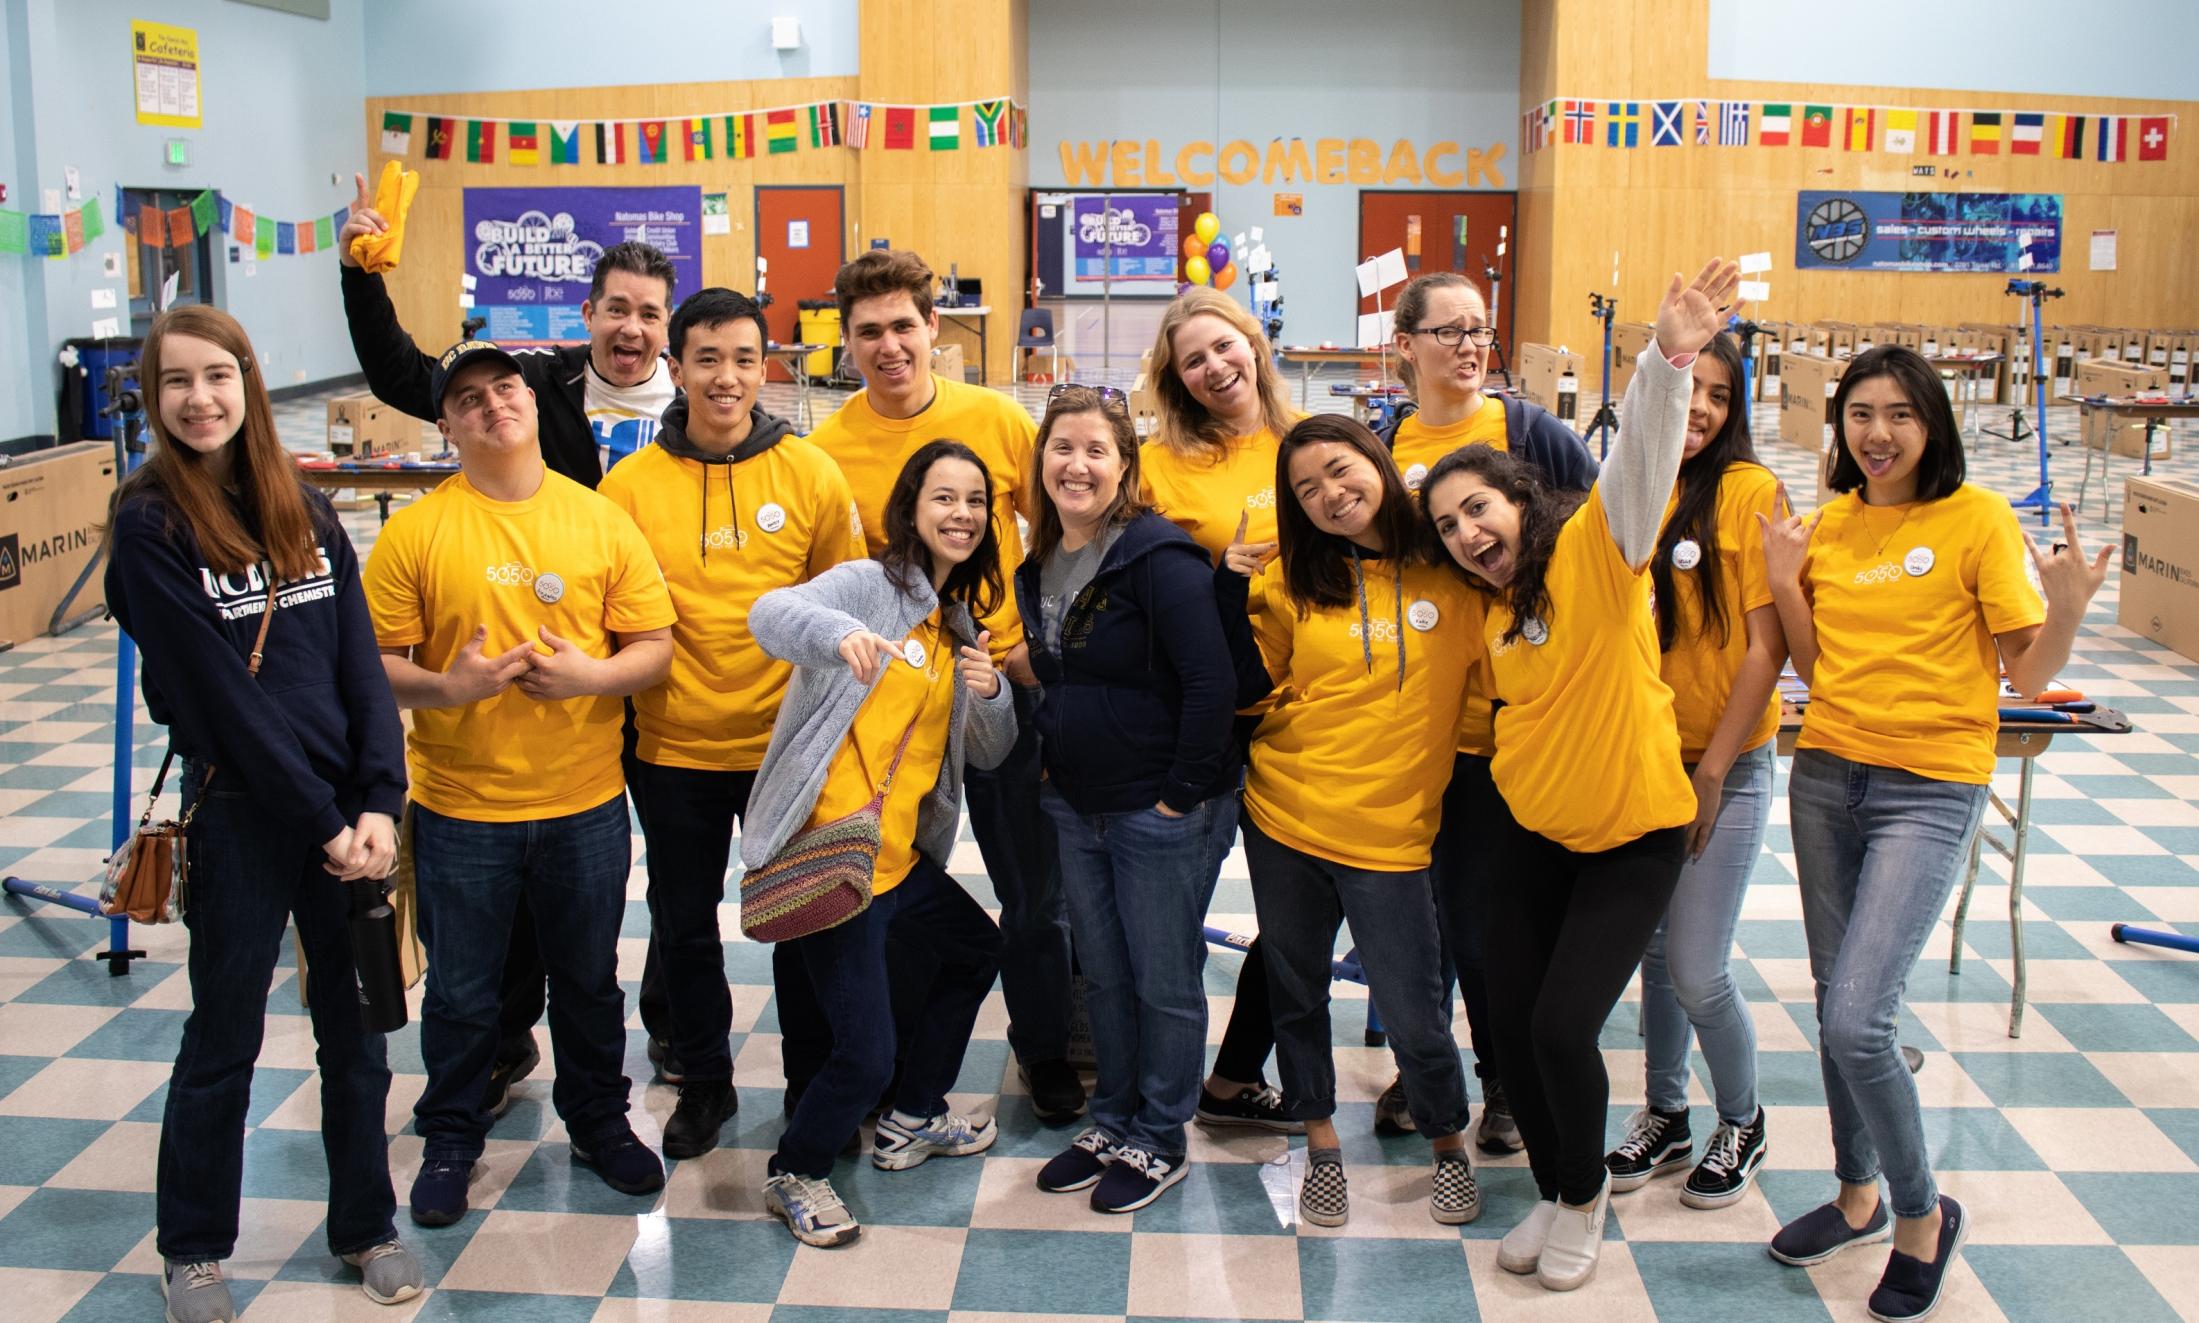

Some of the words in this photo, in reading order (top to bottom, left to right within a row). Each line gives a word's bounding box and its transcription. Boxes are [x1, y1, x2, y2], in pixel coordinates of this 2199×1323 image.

[648, 211, 664, 221] Bike
[665, 211, 684, 223] Shop
[491, 226, 550, 244] BUILD
[1876, 224, 1907, 235] sales
[1917, 226, 1961, 236] custom
[1963, 226, 2006, 236] wheels
[524, 243, 577, 255] BETTER
[492, 254, 586, 277] FUTURE
[1247, 489, 1276, 508] 505
[21, 528, 87, 568] MARIN
[486, 565, 534, 583] 5050
[1854, 564, 1903, 584] 5050
[2138, 551, 2180, 582] MARIN
